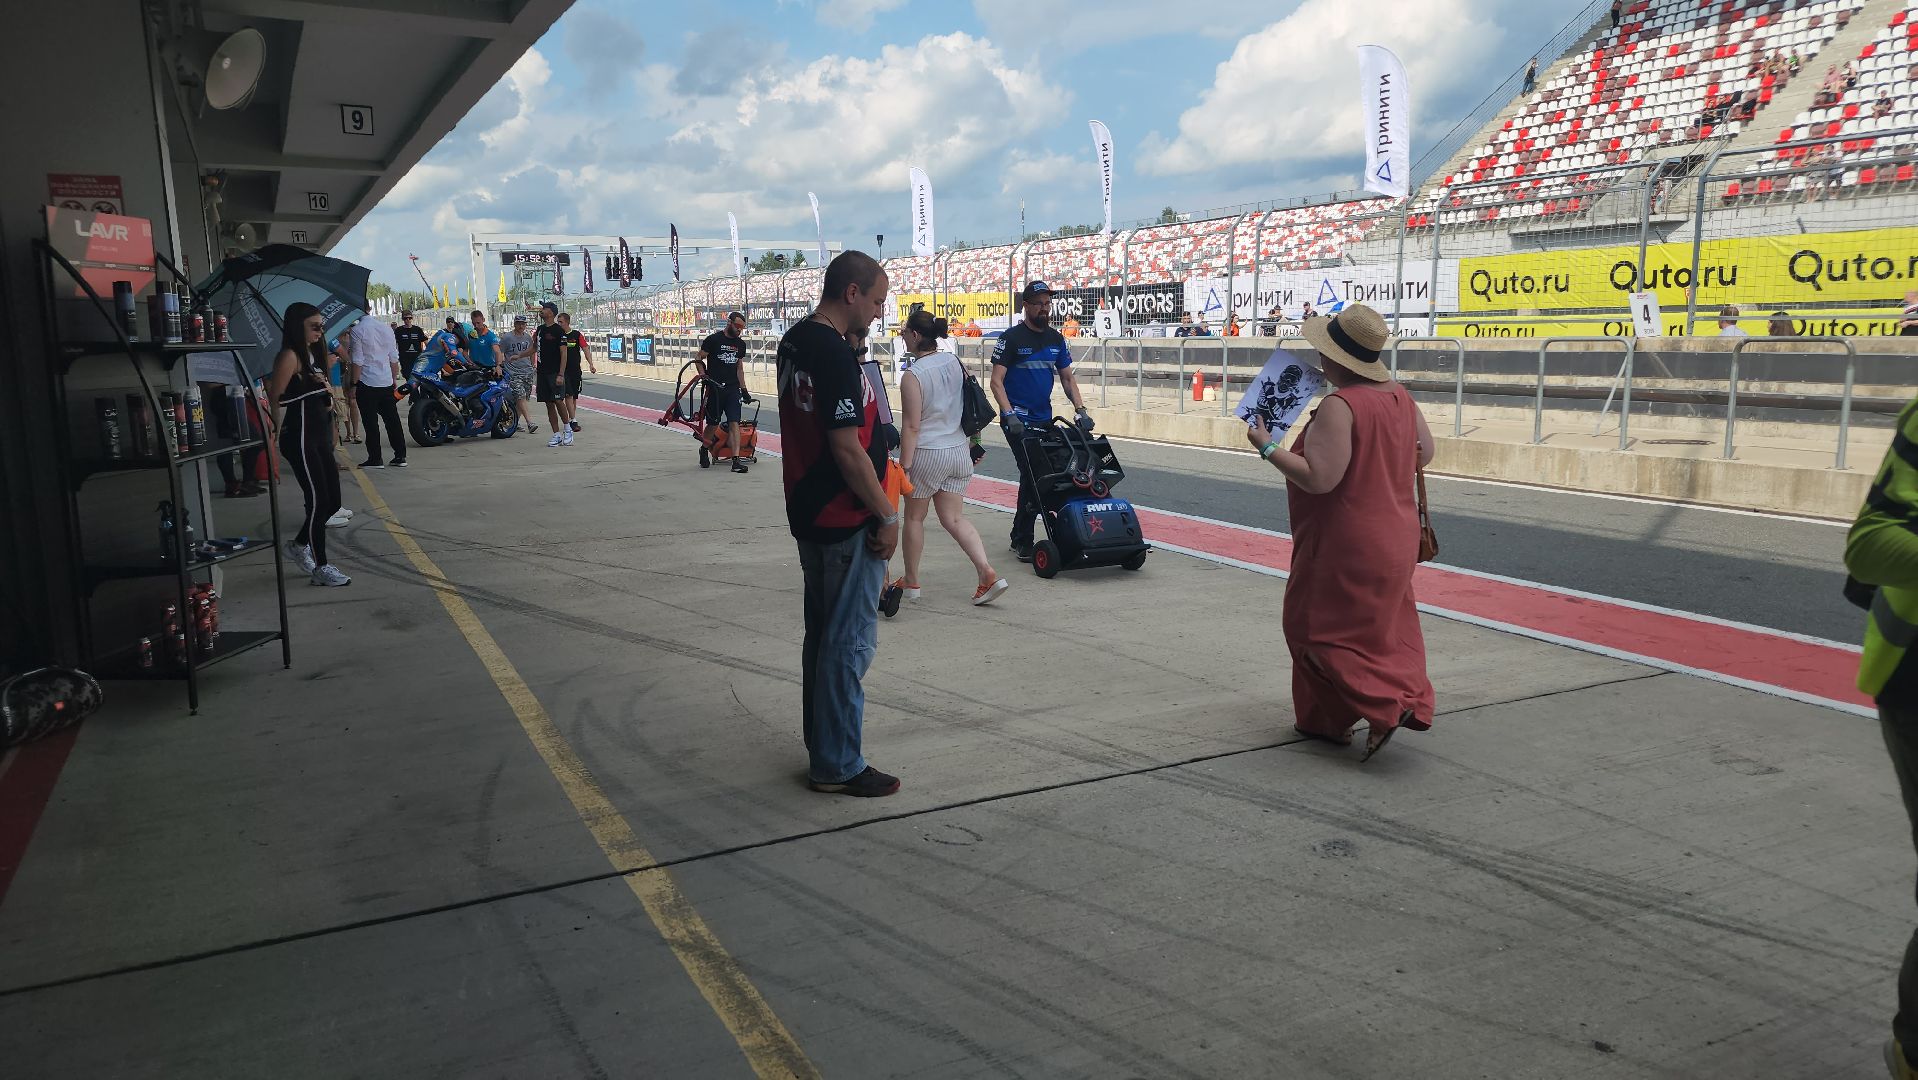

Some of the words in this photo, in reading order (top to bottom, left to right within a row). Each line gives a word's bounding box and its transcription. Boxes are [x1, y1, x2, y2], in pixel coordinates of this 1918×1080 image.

[352, 110, 363, 130] 9
[1377, 74, 1392, 158] Тринити
[312, 196, 326, 208] 10
[75, 220, 128, 241] LAVR
[295, 232, 305, 243] 11
[1470, 269, 1570, 302] Quto.ru
[1610, 261, 1738, 295] Quto.ru
[1115, 292, 1174, 314] MOTORS
[1225, 288, 1293, 311] ринити
[1342, 281, 1428, 302] Тринити
[937, 302, 966, 317] motor
[977, 301, 1009, 317] motor
[1049, 297, 1083, 317] TORS
[1643, 304, 1651, 324] 4
[1104, 317, 1111, 329] 3
[1087, 503, 1113, 512] RWT
